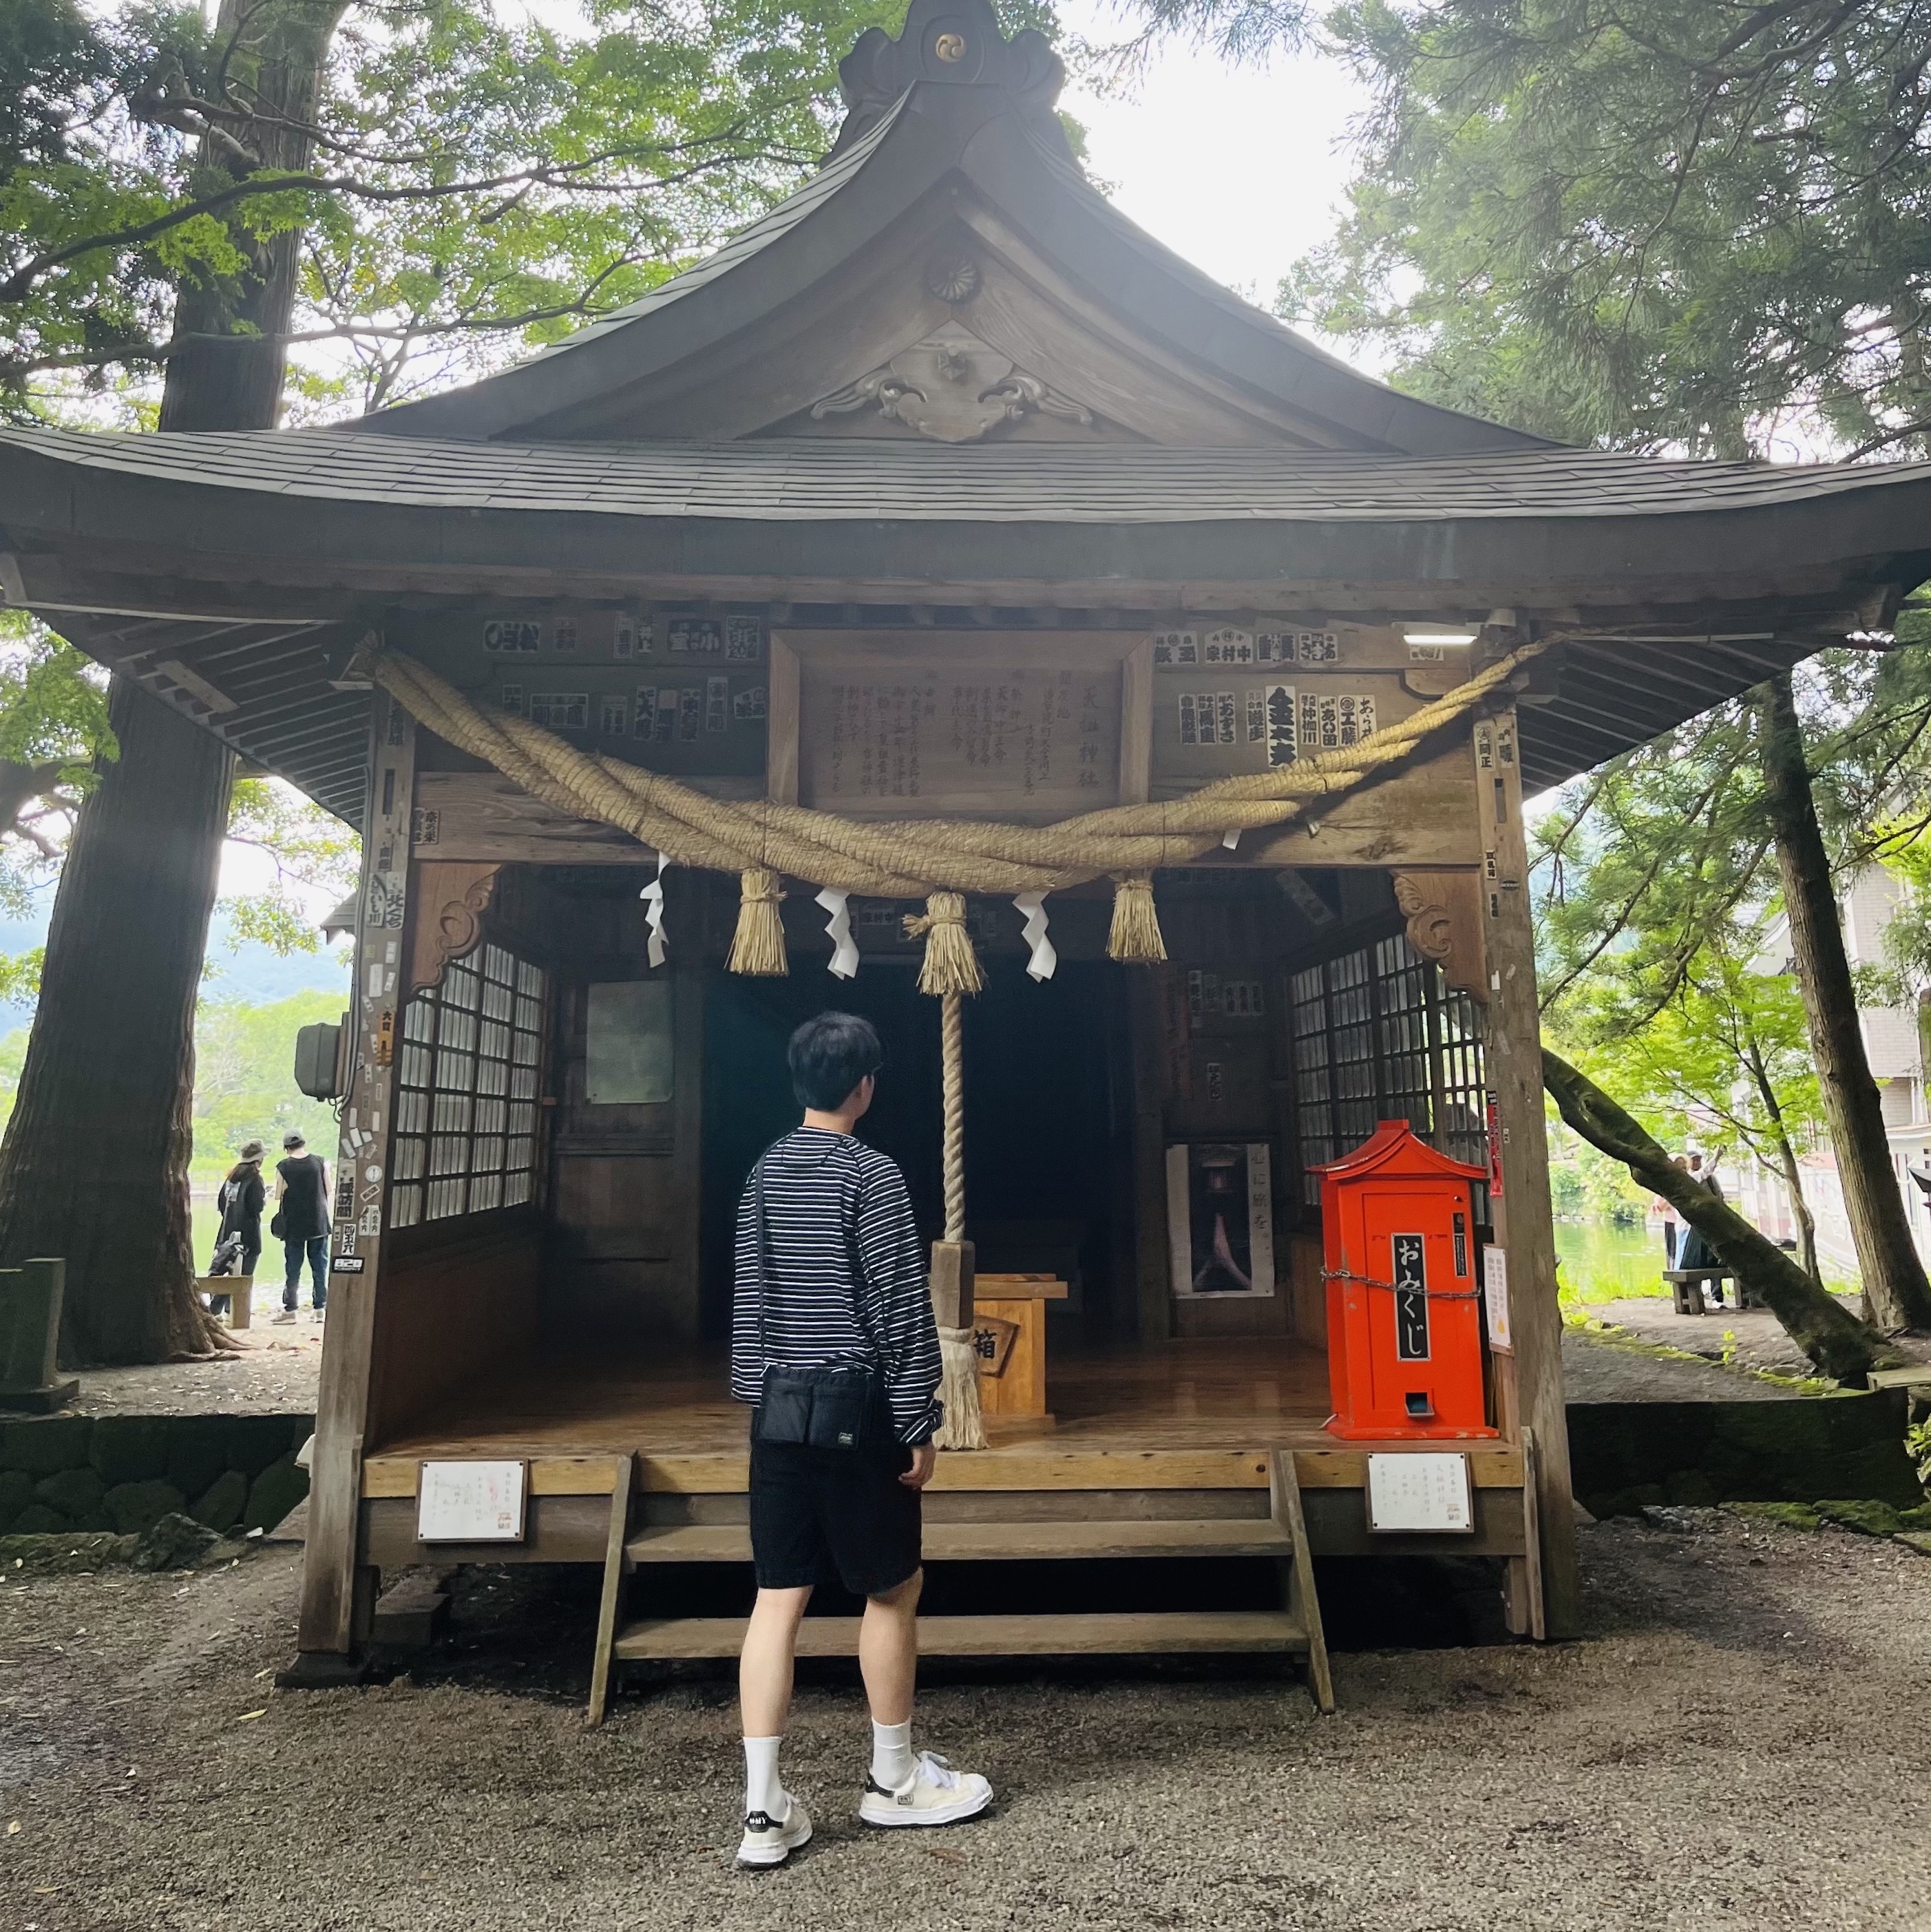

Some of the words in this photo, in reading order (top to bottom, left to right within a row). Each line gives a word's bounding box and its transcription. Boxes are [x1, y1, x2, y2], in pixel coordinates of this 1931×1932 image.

[1398, 1239, 1424, 1355] おみくじ
[973, 1328, 997, 1359] 箱
